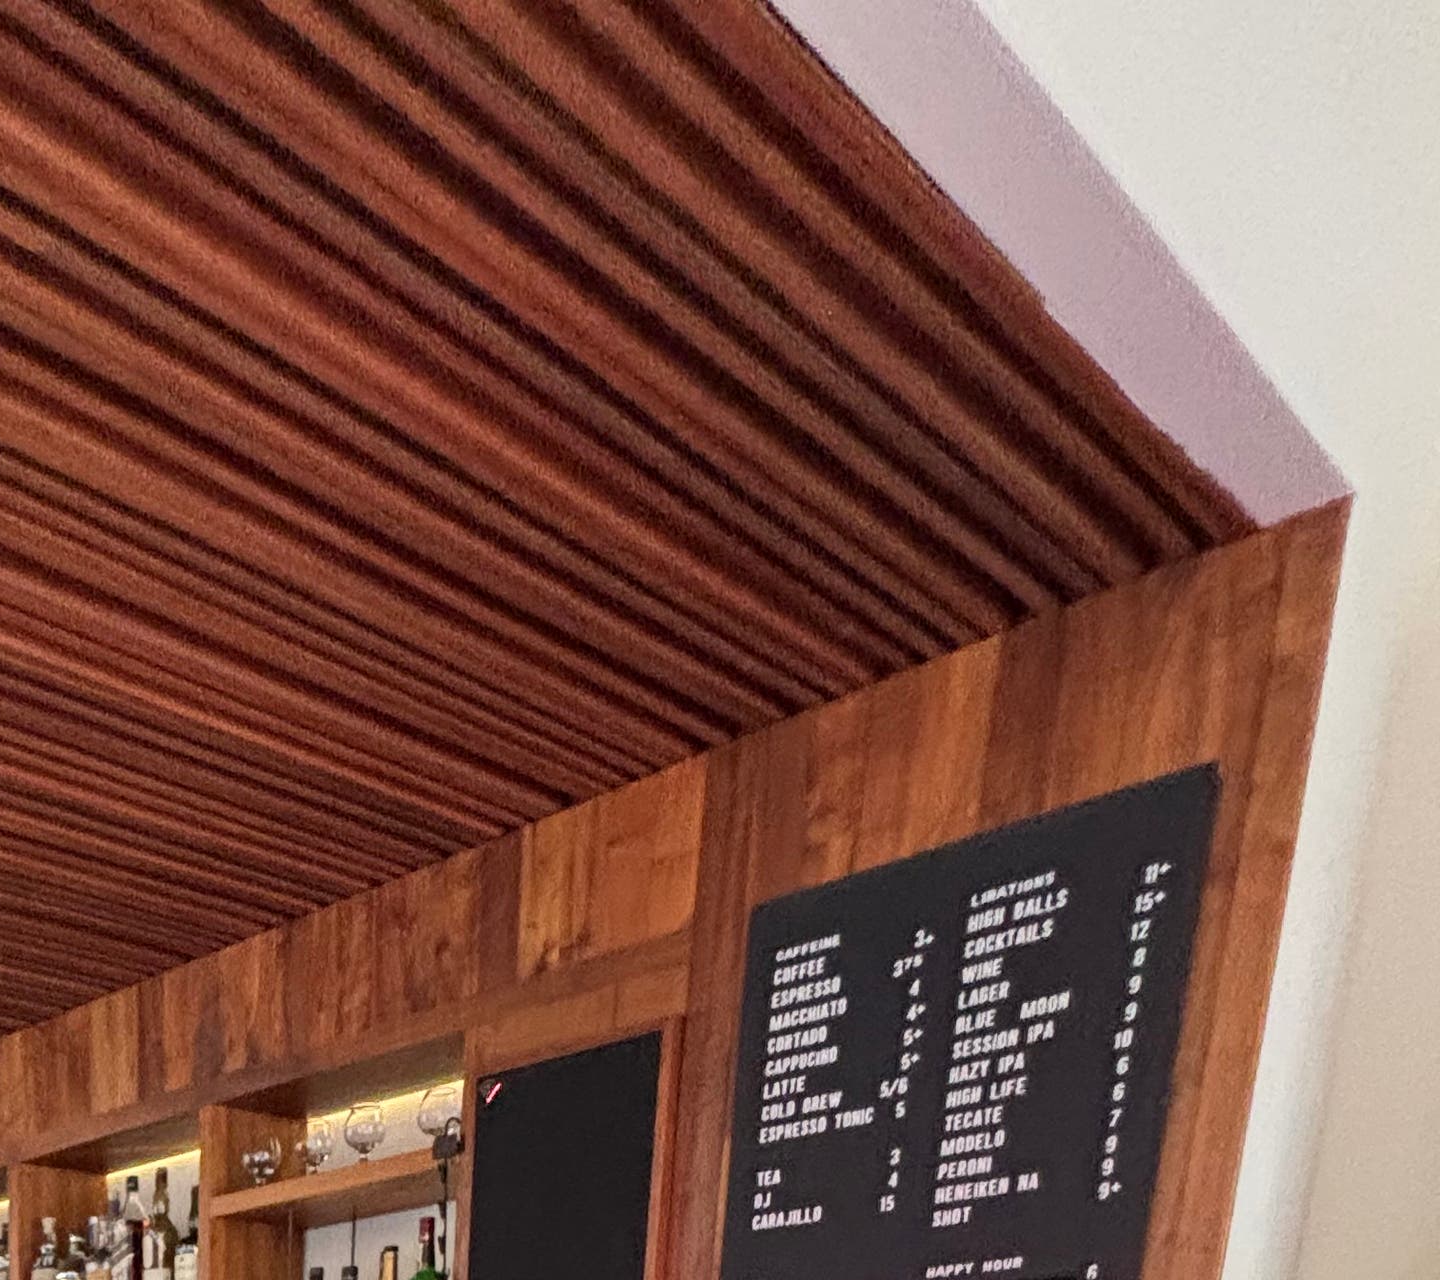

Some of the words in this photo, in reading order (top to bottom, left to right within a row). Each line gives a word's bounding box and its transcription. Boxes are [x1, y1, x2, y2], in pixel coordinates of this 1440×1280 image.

[966, 906, 1006, 933] HIGH
[1013, 888, 1069, 921] BALLS
[961, 957, 1004, 985] WINE
[1130, 919, 1152, 941] 12
[962, 918, 1054, 960] COCKTAILS
[773, 956, 827, 986] COFFEE
[768, 997, 848, 1032] MACCHIATO
[909, 978, 921, 996] 4
[770, 975, 841, 1009] ESPRESSO
[955, 1009, 997, 1035] BLUE
[1020, 989, 1071, 1020] MOON
[1128, 975, 1142, 995] 9
[957, 980, 1010, 1010] LAGER
[767, 1025, 828, 1054] CORTADO
[952, 1028, 1020, 1060] SESSION
[1026, 1020, 1055, 1044] IPA
[1124, 1002, 1138, 1022] 9
[764, 1046, 838, 1077] CAPPUCINO
[948, 1059, 990, 1084] HAZY
[997, 1052, 1025, 1074] IPA
[1113, 1028, 1134, 1049] 10
[762, 1076, 806, 1100] LATTE
[945, 1085, 982, 1109] HIGH
[989, 1076, 1027, 1101] LIFE
[1115, 1056, 1130, 1076] 6
[761, 1101, 796, 1122] COLD
[802, 1090, 843, 1114] BREW
[944, 1105, 1004, 1131] TECATE
[759, 1116, 827, 1144] ESPRESSO
[834, 1107, 875, 1129] TONIC
[940, 1129, 1006, 1157] MODELO
[1109, 1108, 1123, 1128] 7
[756, 1169, 781, 1187] TEA
[890, 1148, 901, 1166] 3
[936, 1156, 993, 1180] PERONI
[1105, 1135, 1118, 1154] 9
[1016, 1172, 1039, 1192] NA
[1101, 1158, 1114, 1177] 9
[888, 1171, 898, 1188] 4
[751, 1205, 823, 1230] CARAJILLO
[880, 1195, 896, 1212] 15
[932, 1206, 972, 1228] SHOT
[925, 1262, 974, 1279] HAPPY
[981, 1256, 1023, 1273] HOUR
